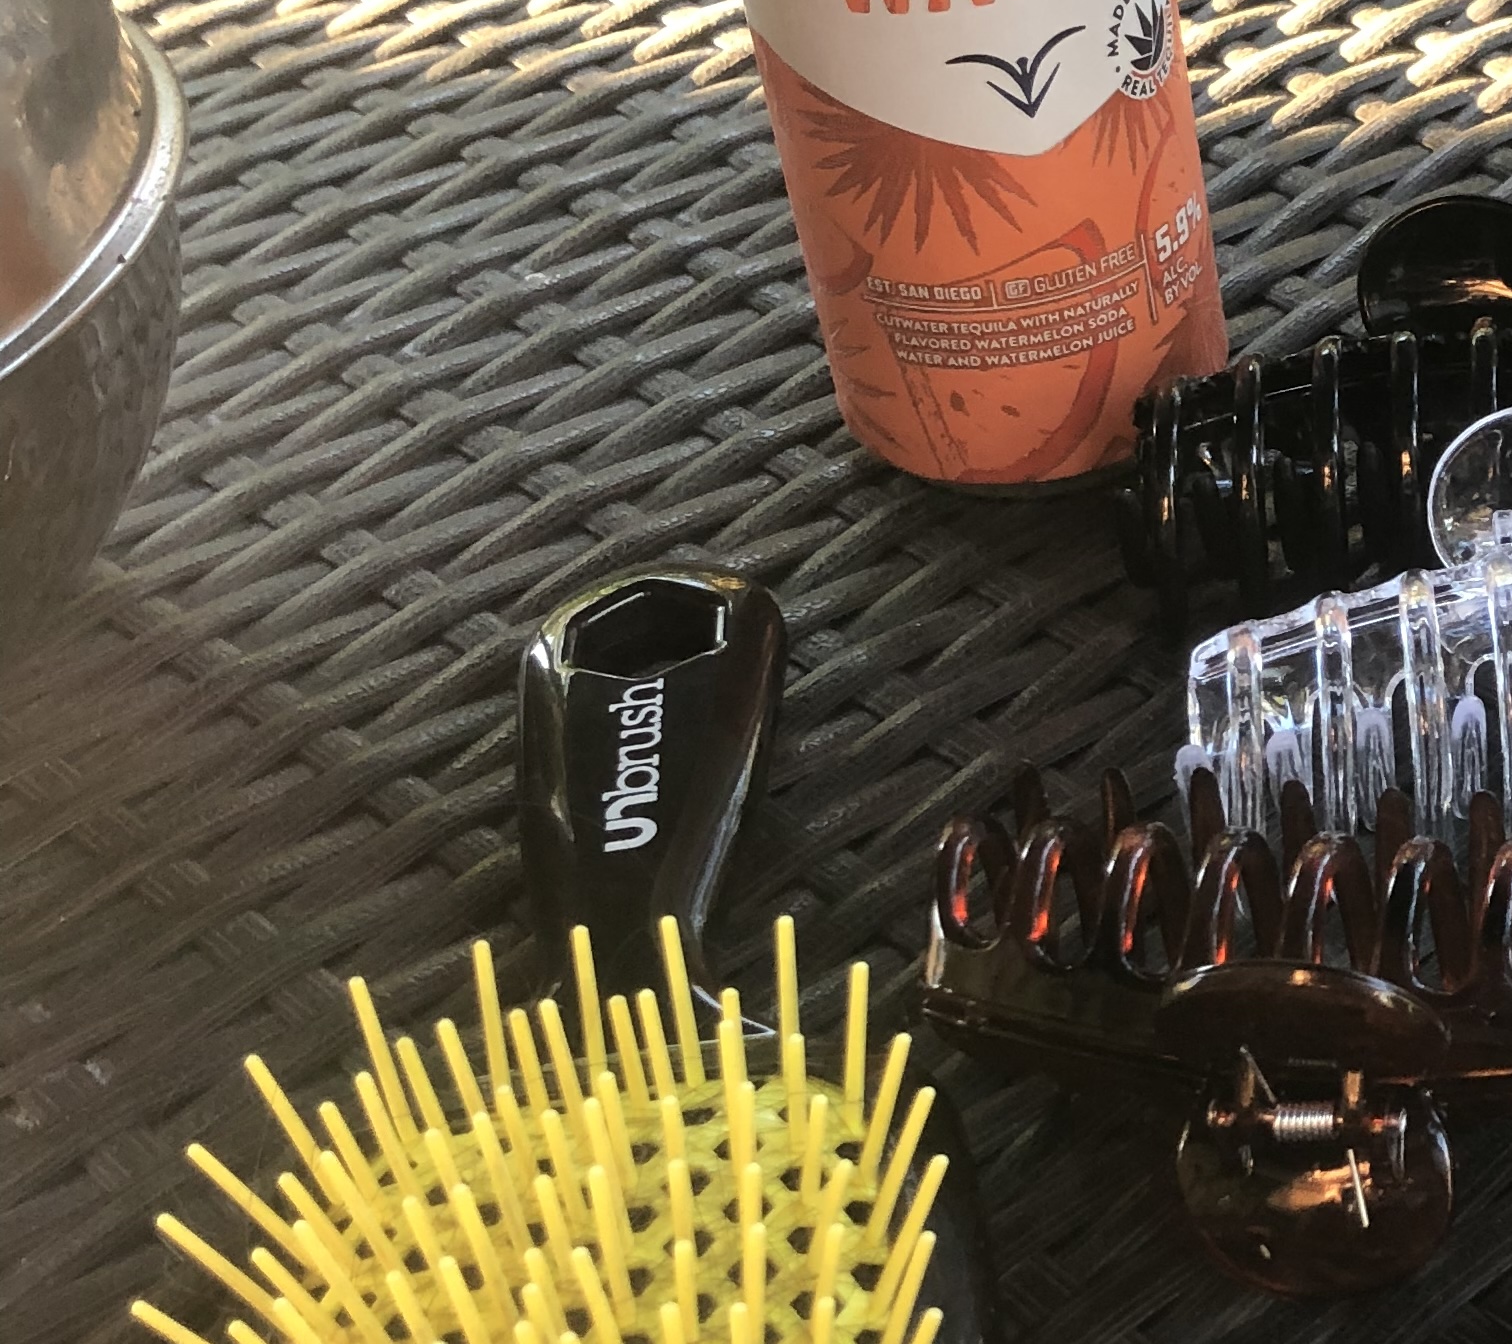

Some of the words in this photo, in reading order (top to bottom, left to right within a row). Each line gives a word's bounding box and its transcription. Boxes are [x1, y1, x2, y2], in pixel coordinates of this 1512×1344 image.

[1121, 74, 1156, 97] REAL
[1155, 190, 1202, 263] 5.9%
[898, 284, 930, 301] SAN
[933, 286, 983, 302] DIEGO
[1034, 265, 1097, 294] GLUTEN
[1100, 243, 1136, 273] FREE
[1165, 280, 1180, 305] BY
[876, 312, 949, 335] CUTWATER
[951, 319, 1018, 336] TEQUILA
[1020, 312, 1060, 330] WITH
[1063, 280, 1140, 319] NATURALLY
[894, 332, 972, 352] FLAVORED
[975, 323, 1085, 351] WATERMELON
[1088, 306, 1128, 329] SODA
[896, 349, 943, 367] WATER
[946, 355, 982, 369] AND
[984, 339, 1094, 367] WATERMELON
[1096, 319, 1136, 344] JUICE
[602, 677, 664, 853] Unbrush
